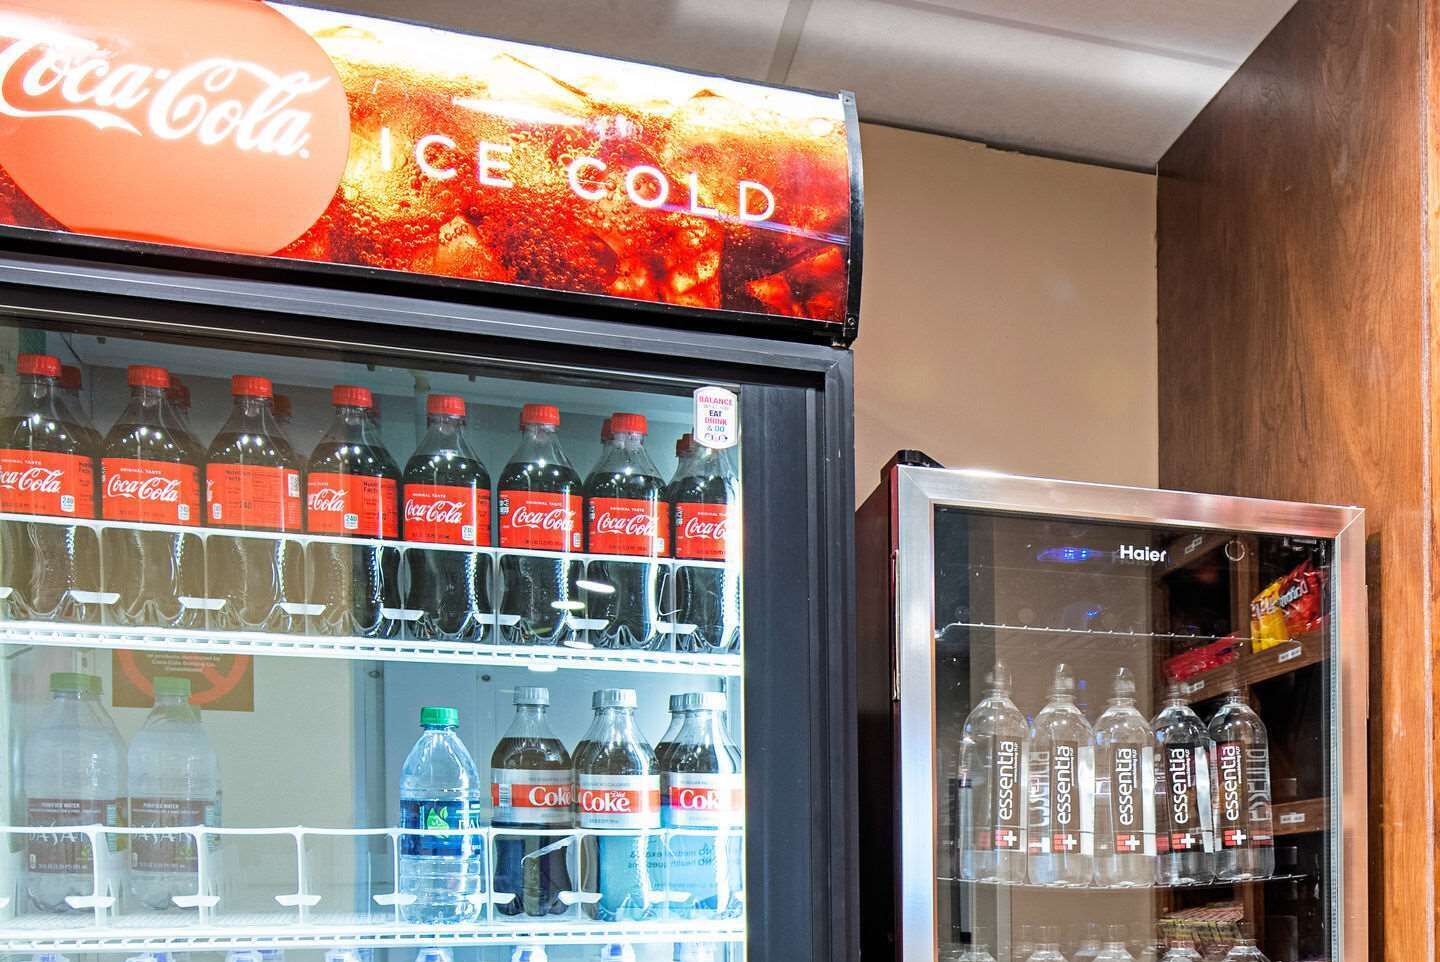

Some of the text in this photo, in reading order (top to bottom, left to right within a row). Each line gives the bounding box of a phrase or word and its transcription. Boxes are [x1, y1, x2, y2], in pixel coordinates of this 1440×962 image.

[0, 36, 331, 159] Coca-Cola
[380, 127, 776, 222] ICE COLD
[699, 395, 732, 406] BALANCE
[709, 409, 722, 417] EAT
[1119, 544, 1167, 563] Haier
[528, 786, 572, 807] Coke
[582, 790, 632, 813] Coke
[997, 741, 1014, 820] essentia
[1054, 745, 1071, 825] essentia
[1115, 748, 1133, 826] essentia
[1169, 748, 1188, 824] essentia
[1220, 745, 1239, 821] essentia
